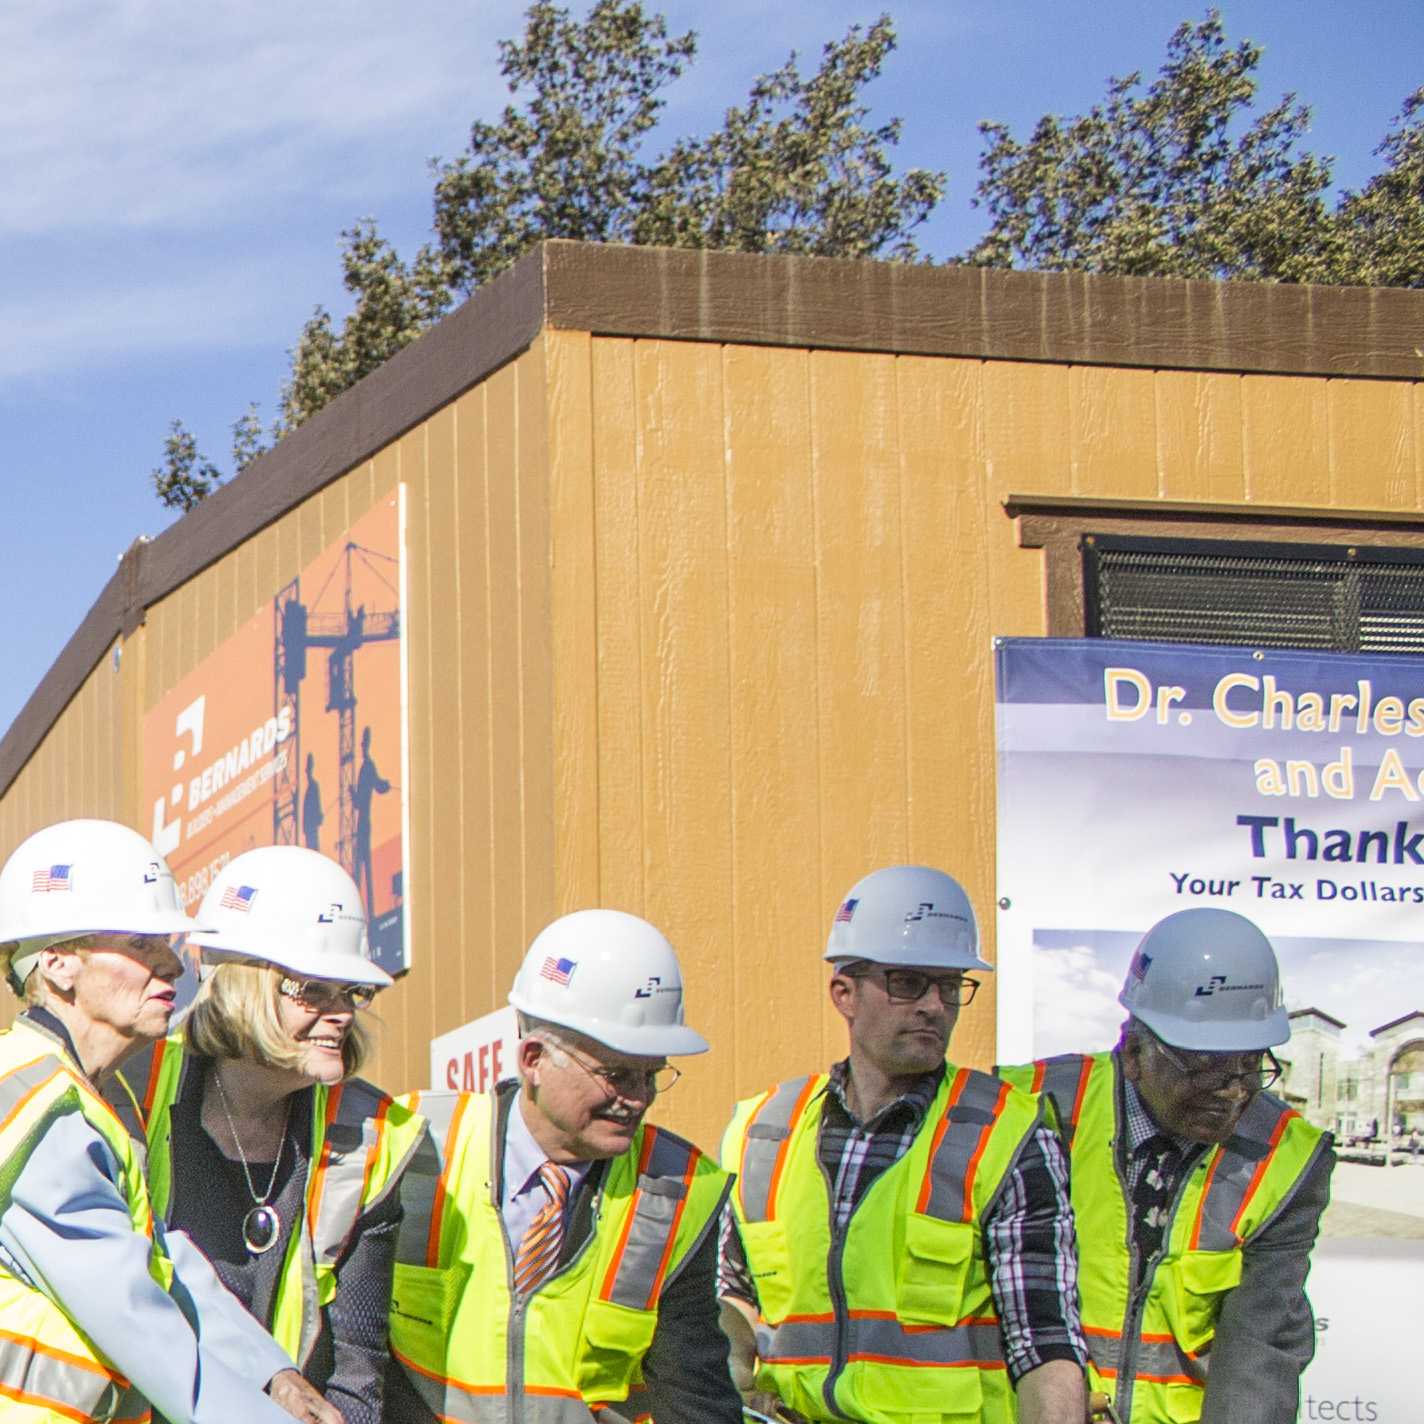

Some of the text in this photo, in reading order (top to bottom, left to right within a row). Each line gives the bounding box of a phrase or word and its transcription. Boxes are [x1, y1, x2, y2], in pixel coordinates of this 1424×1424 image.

[1104, 667, 1424, 737] Dr. Charles
[188, 706, 291, 813] BERNARDS
[1254, 746, 1355, 800] and
[1236, 814, 1424, 866] Thank
[1170, 872, 1424, 903] Your Tax Dollars
